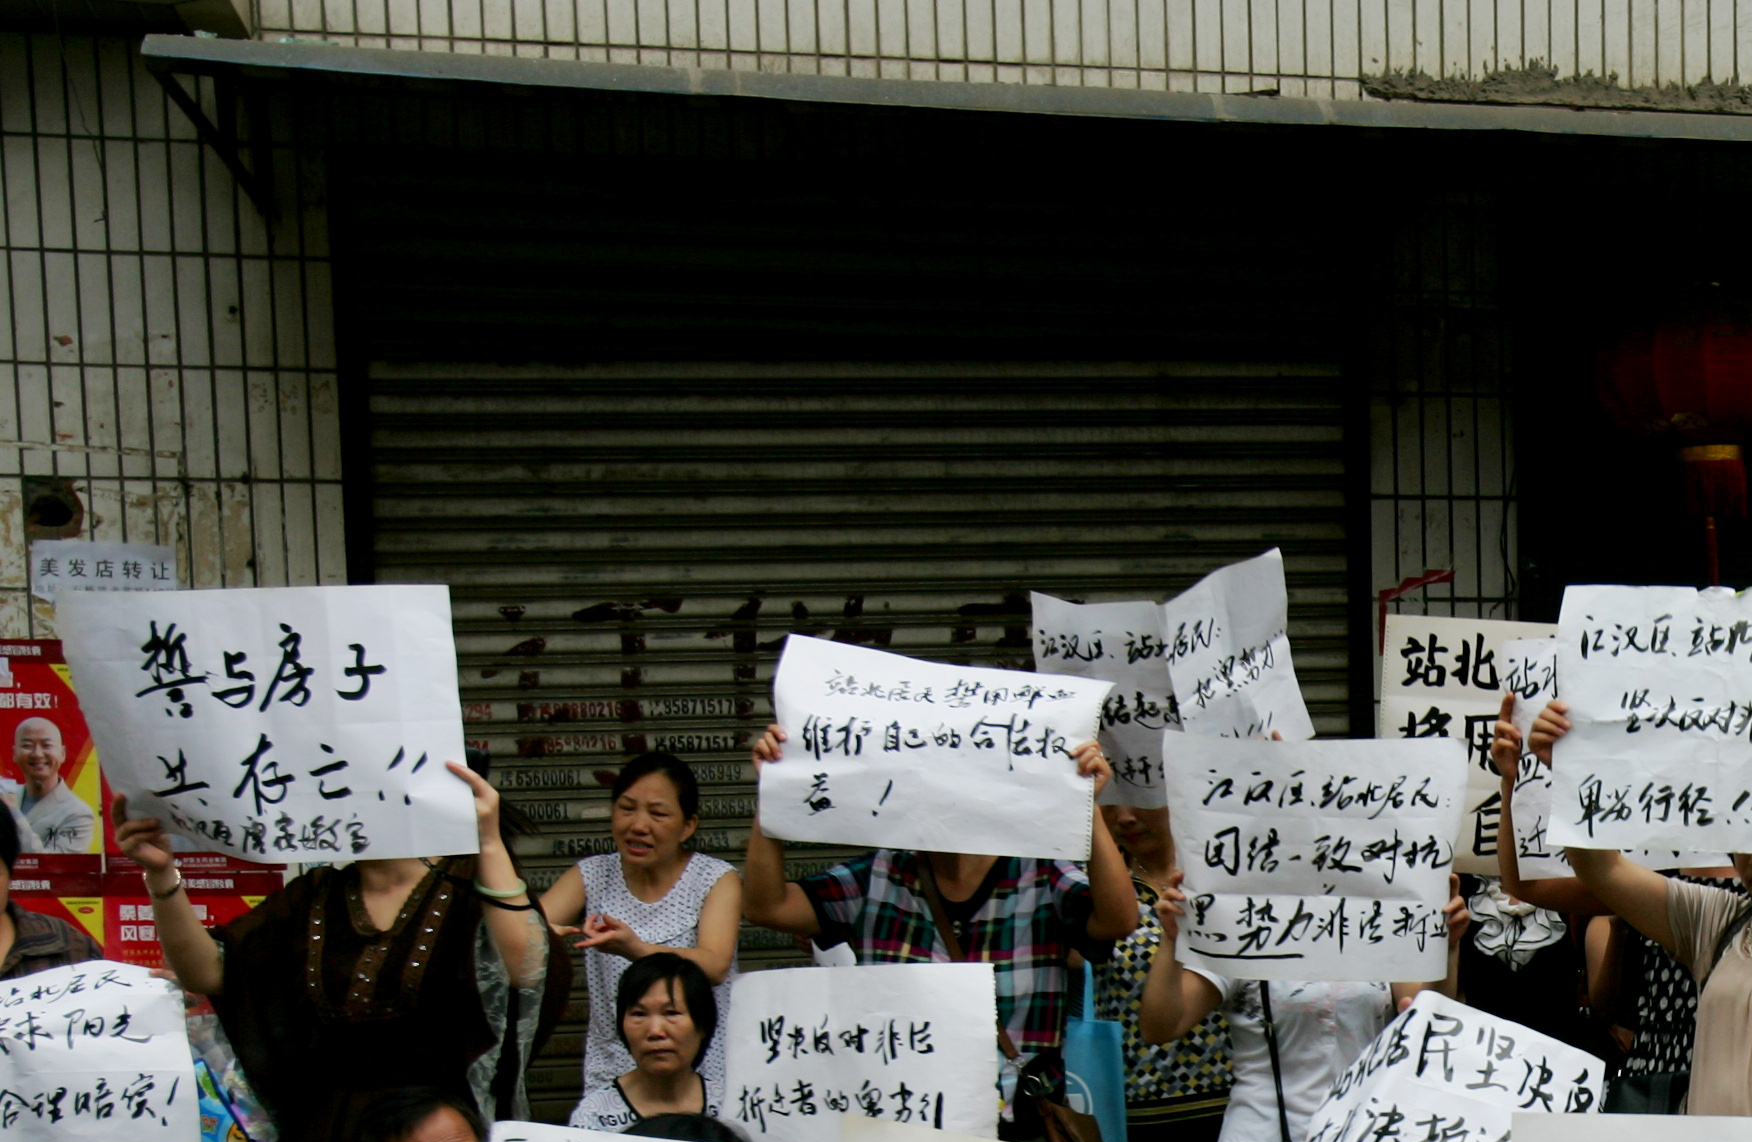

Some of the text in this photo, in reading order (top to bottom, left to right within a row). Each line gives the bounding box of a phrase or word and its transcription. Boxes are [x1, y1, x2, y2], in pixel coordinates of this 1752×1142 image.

[40, 557, 171, 581] 美发店转让
[135, 620, 387, 718] 誓与房子
